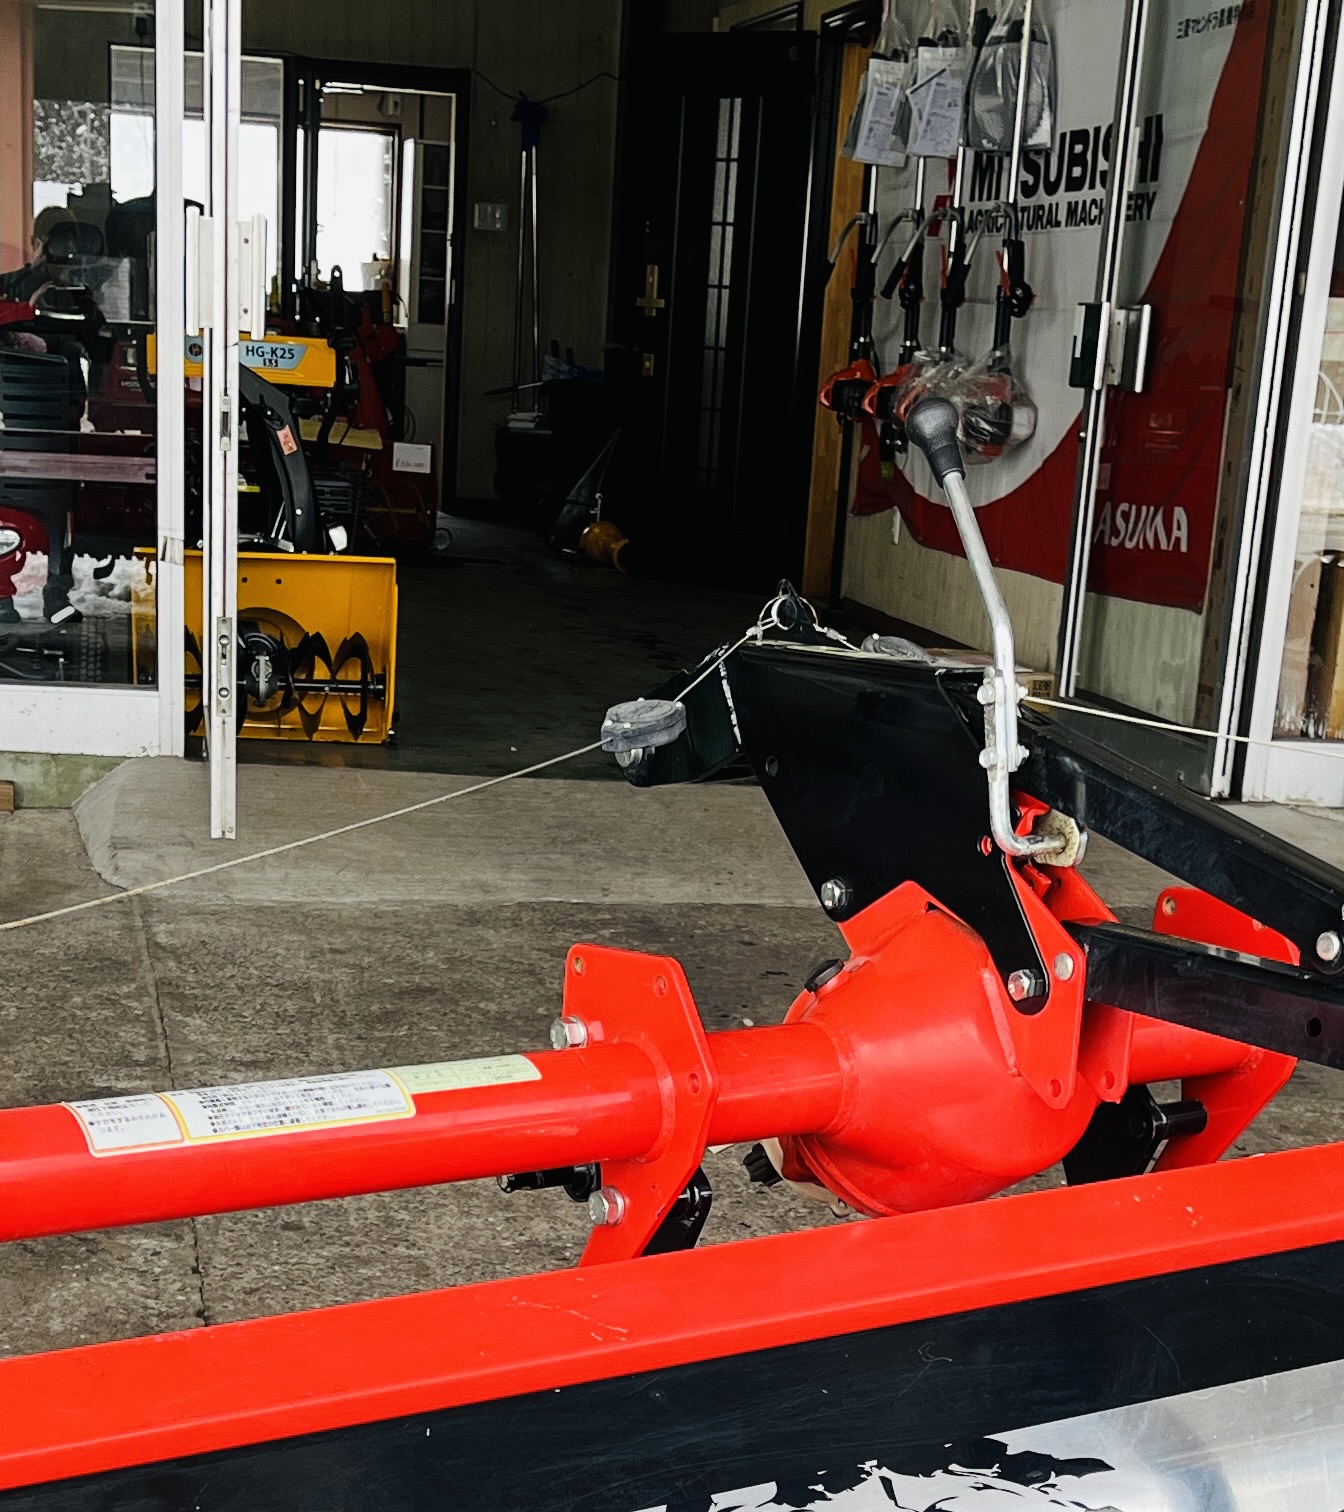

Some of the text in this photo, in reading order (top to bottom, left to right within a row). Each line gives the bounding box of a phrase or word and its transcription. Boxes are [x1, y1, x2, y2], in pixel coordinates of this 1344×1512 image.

[969, 114, 1164, 203] MISUBIHI
[965, 192, 1157, 234] AGRICTURAL MACERY
[245, 345, 295, 360] HG-K25
